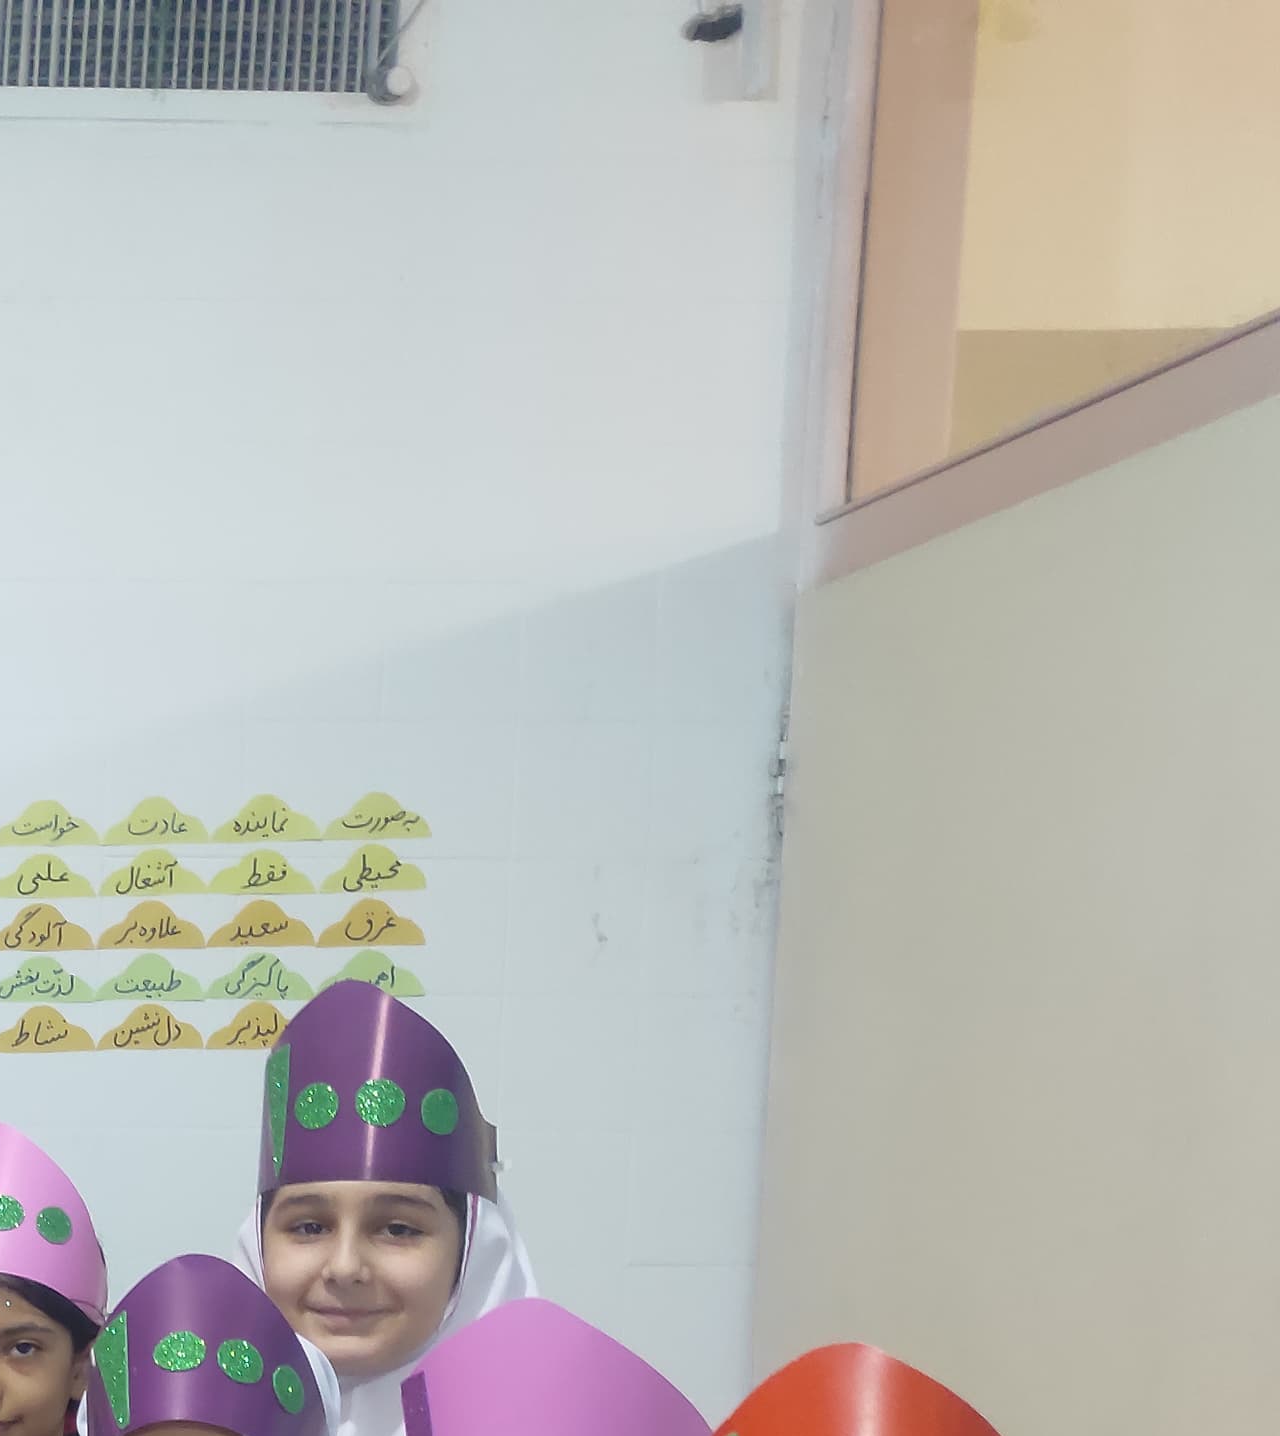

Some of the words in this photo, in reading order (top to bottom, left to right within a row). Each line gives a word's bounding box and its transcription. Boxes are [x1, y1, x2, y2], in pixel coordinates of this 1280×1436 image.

[11, 813, 80, 841] خواست
[128, 812, 188, 836] عادت
[232, 807, 289, 838] نماینده
[17, 861, 71, 896] علمی
[115, 860, 179, 895] آشغال
[242, 857, 288, 889] فقط
[342, 854, 403, 892] محیطی
[4, 907, 69, 948] آلودگی
[230, 919, 289, 946] سعید
[344, 911, 397, 942] غرق
[113, 968, 182, 999] طبیعت
[225, 954, 290, 1000] پاکیزگی
[11, 1018, 69, 1048] نشاط
[227, 1012, 288, 1046] لپذیر
